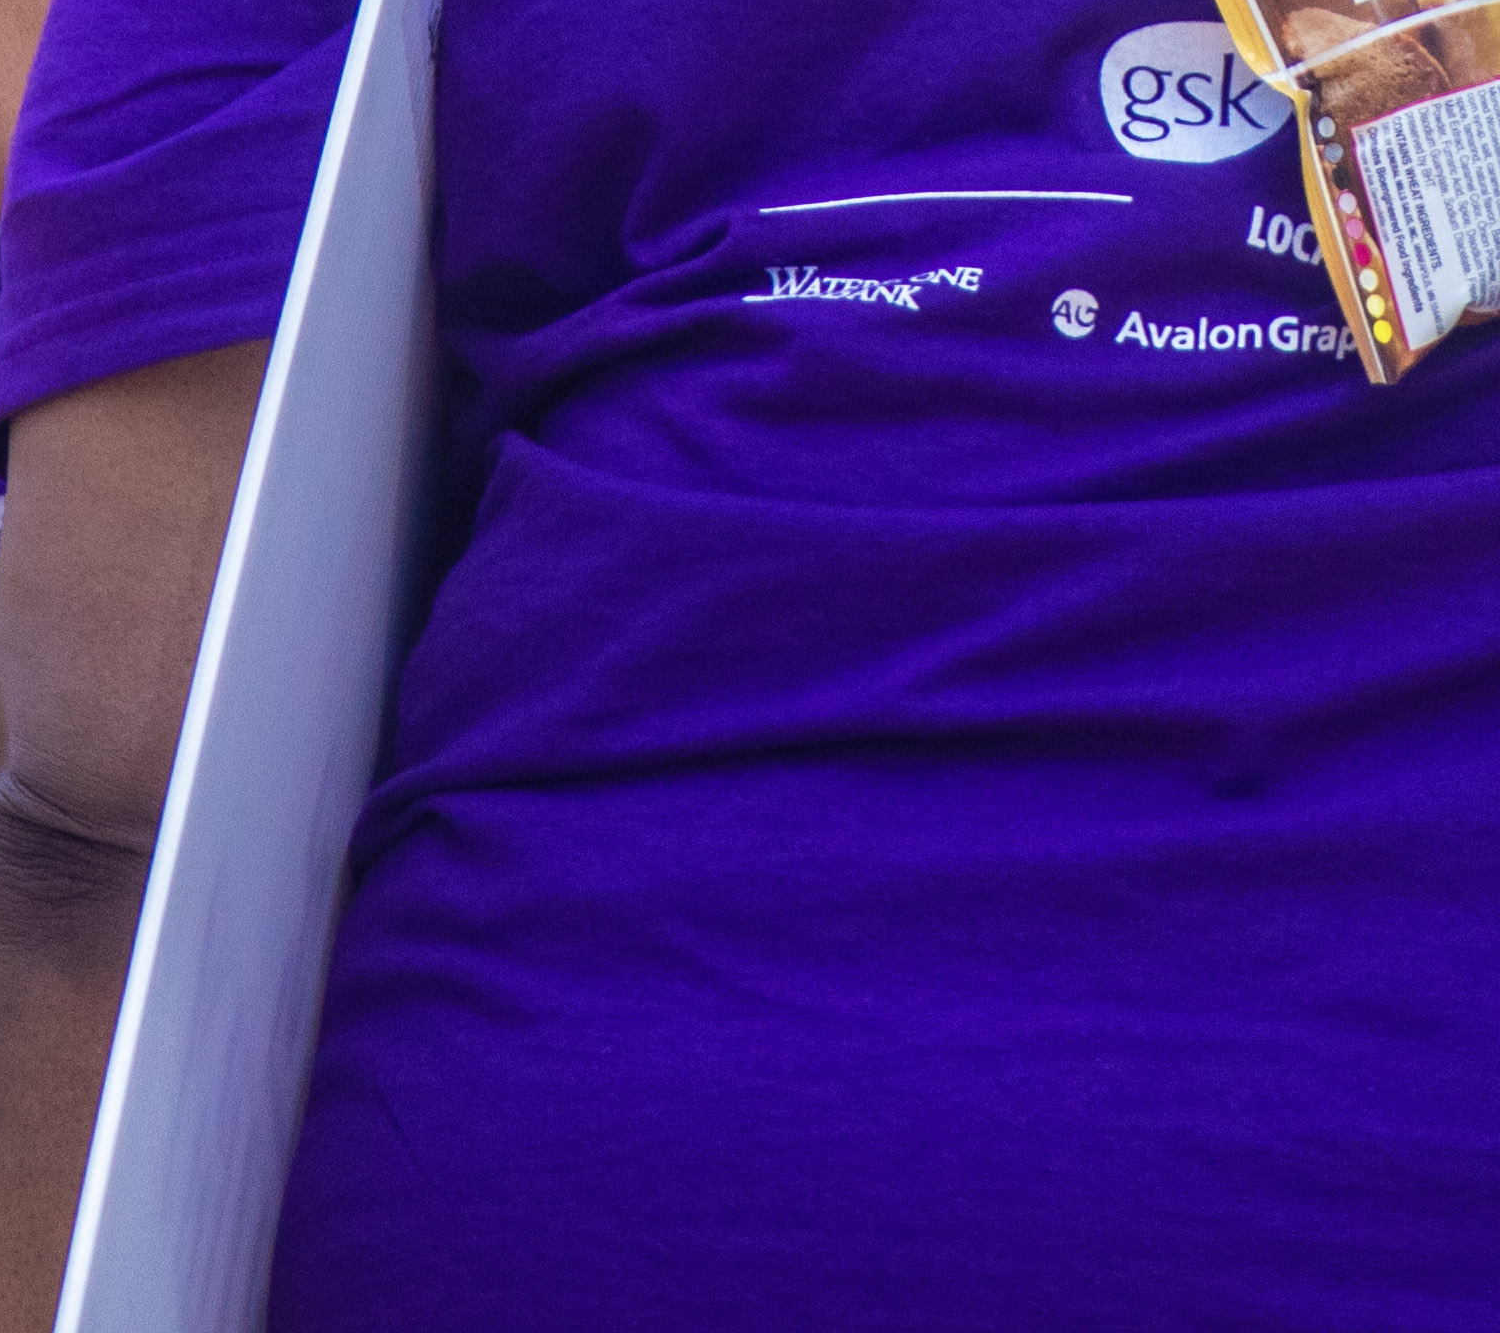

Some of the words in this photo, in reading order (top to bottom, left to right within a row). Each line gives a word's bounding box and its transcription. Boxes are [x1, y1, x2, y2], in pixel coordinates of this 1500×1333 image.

[1119, 49, 1268, 143] gsk
[1443, 98, 1457, 118] Malt
[1466, 92, 1478, 113] corn
[1404, 109, 1425, 154] preserved
[1417, 105, 1438, 148] Disodium
[1430, 102, 1449, 138] Powder,
[1449, 119, 1466, 154] Extract,
[1470, 114, 1485, 140] syrup,
[1365, 126, 1385, 165] Contains
[1385, 146, 1401, 178] GENERAL
[1414, 154, 1429, 167] by
[1441, 139, 1459, 175] Fumaric
[1454, 95, 1468, 122] spice,
[1474, 165, 1489, 196] natural
[1480, 142, 1492, 160] salt,
[1427, 147, 1452, 196] Guanylate,
[1450, 175, 1465, 199] Acid,
[1458, 154, 1477, 192] Caramel
[1485, 162, 1500, 197] caramel
[1373, 166, 1402, 234] Bioengineered
[1390, 115, 1413, 165] CONTAINS
[1403, 165, 1423, 202] WHEAT
[1414, 202, 1443, 272] INGREDIENTS.
[1394, 179, 1408, 200] MILLS
[1468, 192, 1484, 219] Color,
[1400, 202, 1414, 226] SALES,
[1442, 196, 1462, 230] Sodium
[1457, 198, 1474, 228] Spice,
[1393, 234, 1409, 259] Food
[1466, 228, 1485, 269] Disodium
[1476, 220, 1492, 247] Onion
[1453, 231, 1473, 275] Diacetate,
[1398, 259, 1424, 314] Ingredients
